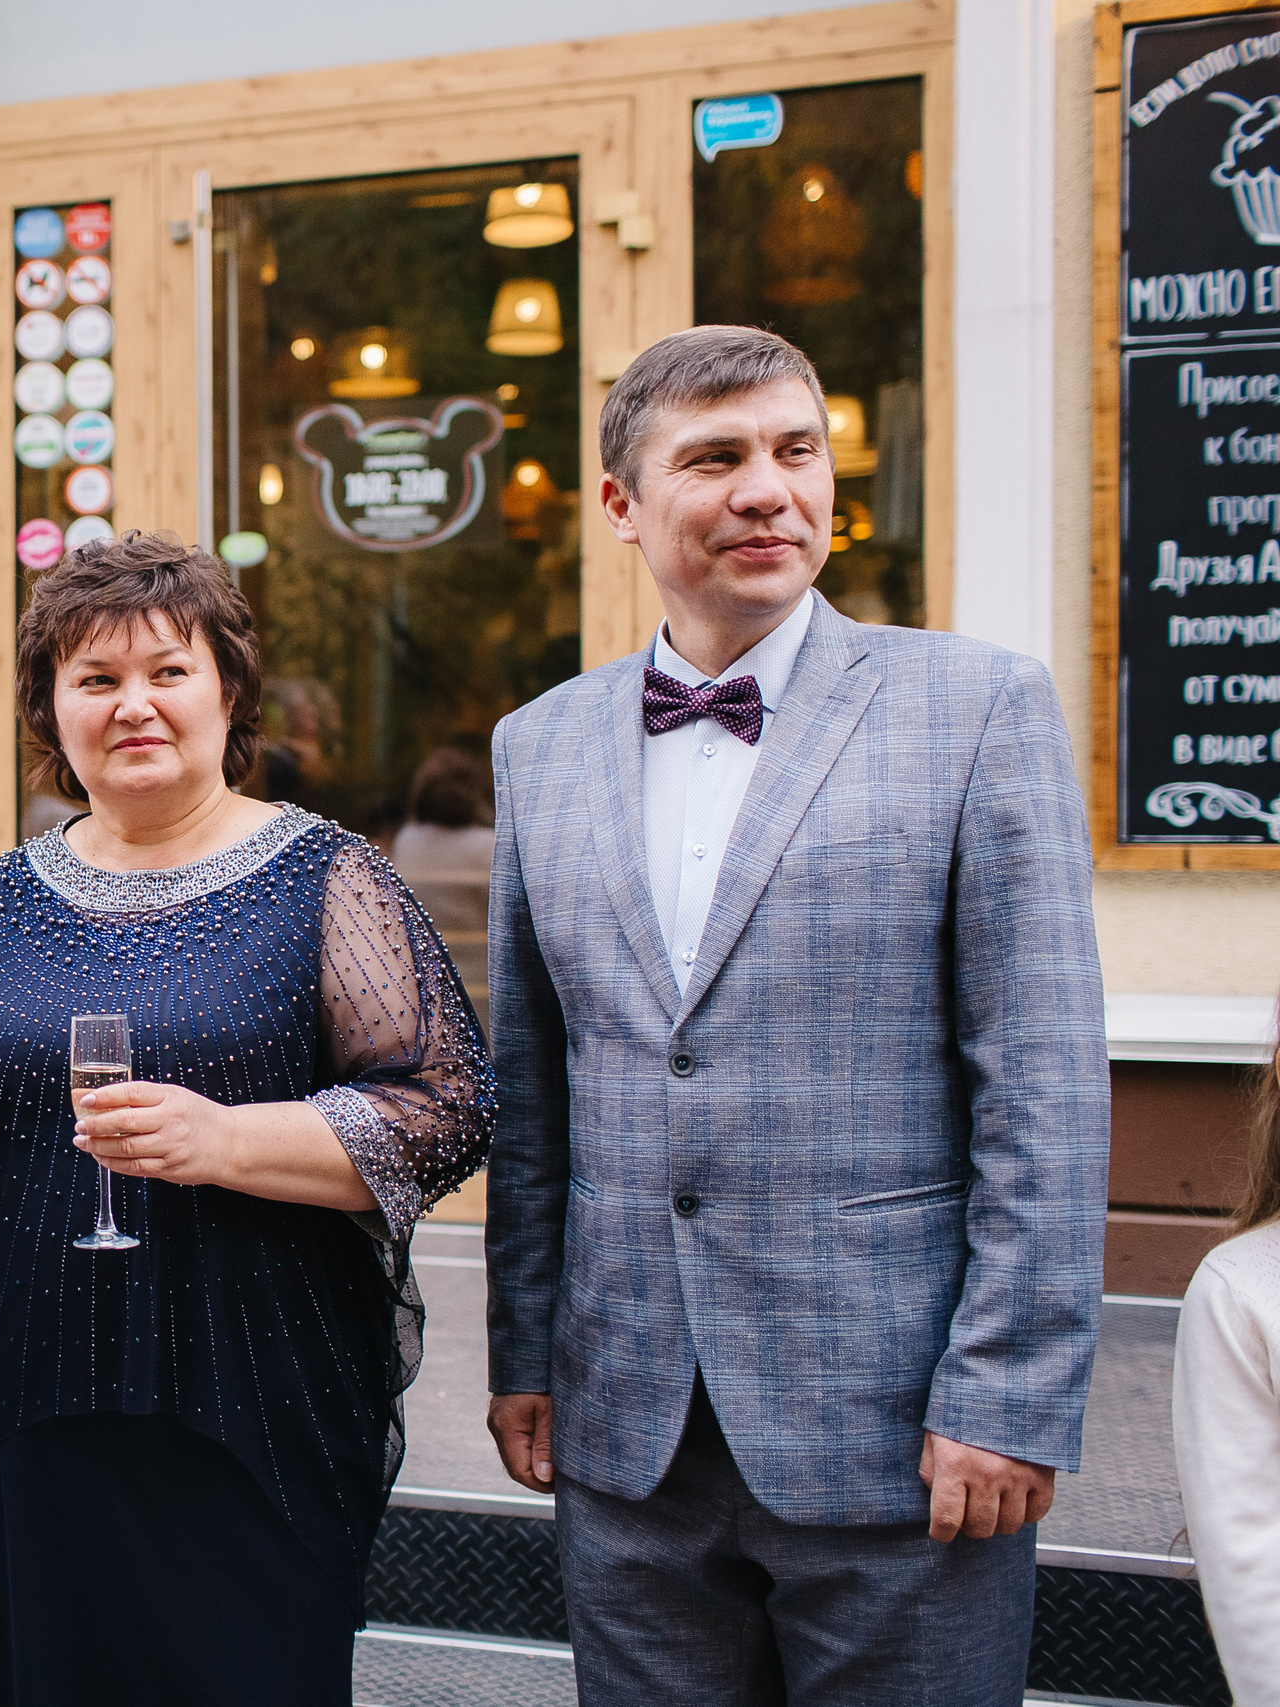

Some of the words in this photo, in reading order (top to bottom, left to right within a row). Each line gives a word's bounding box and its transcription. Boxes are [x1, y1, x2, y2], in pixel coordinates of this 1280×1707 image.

[1129, 268, 1248, 323] МОЖНО
[1178, 361, 1280, 419] Присое
[1149, 539, 1255, 598] Друзья
[1198, 733, 1269, 766] виде
